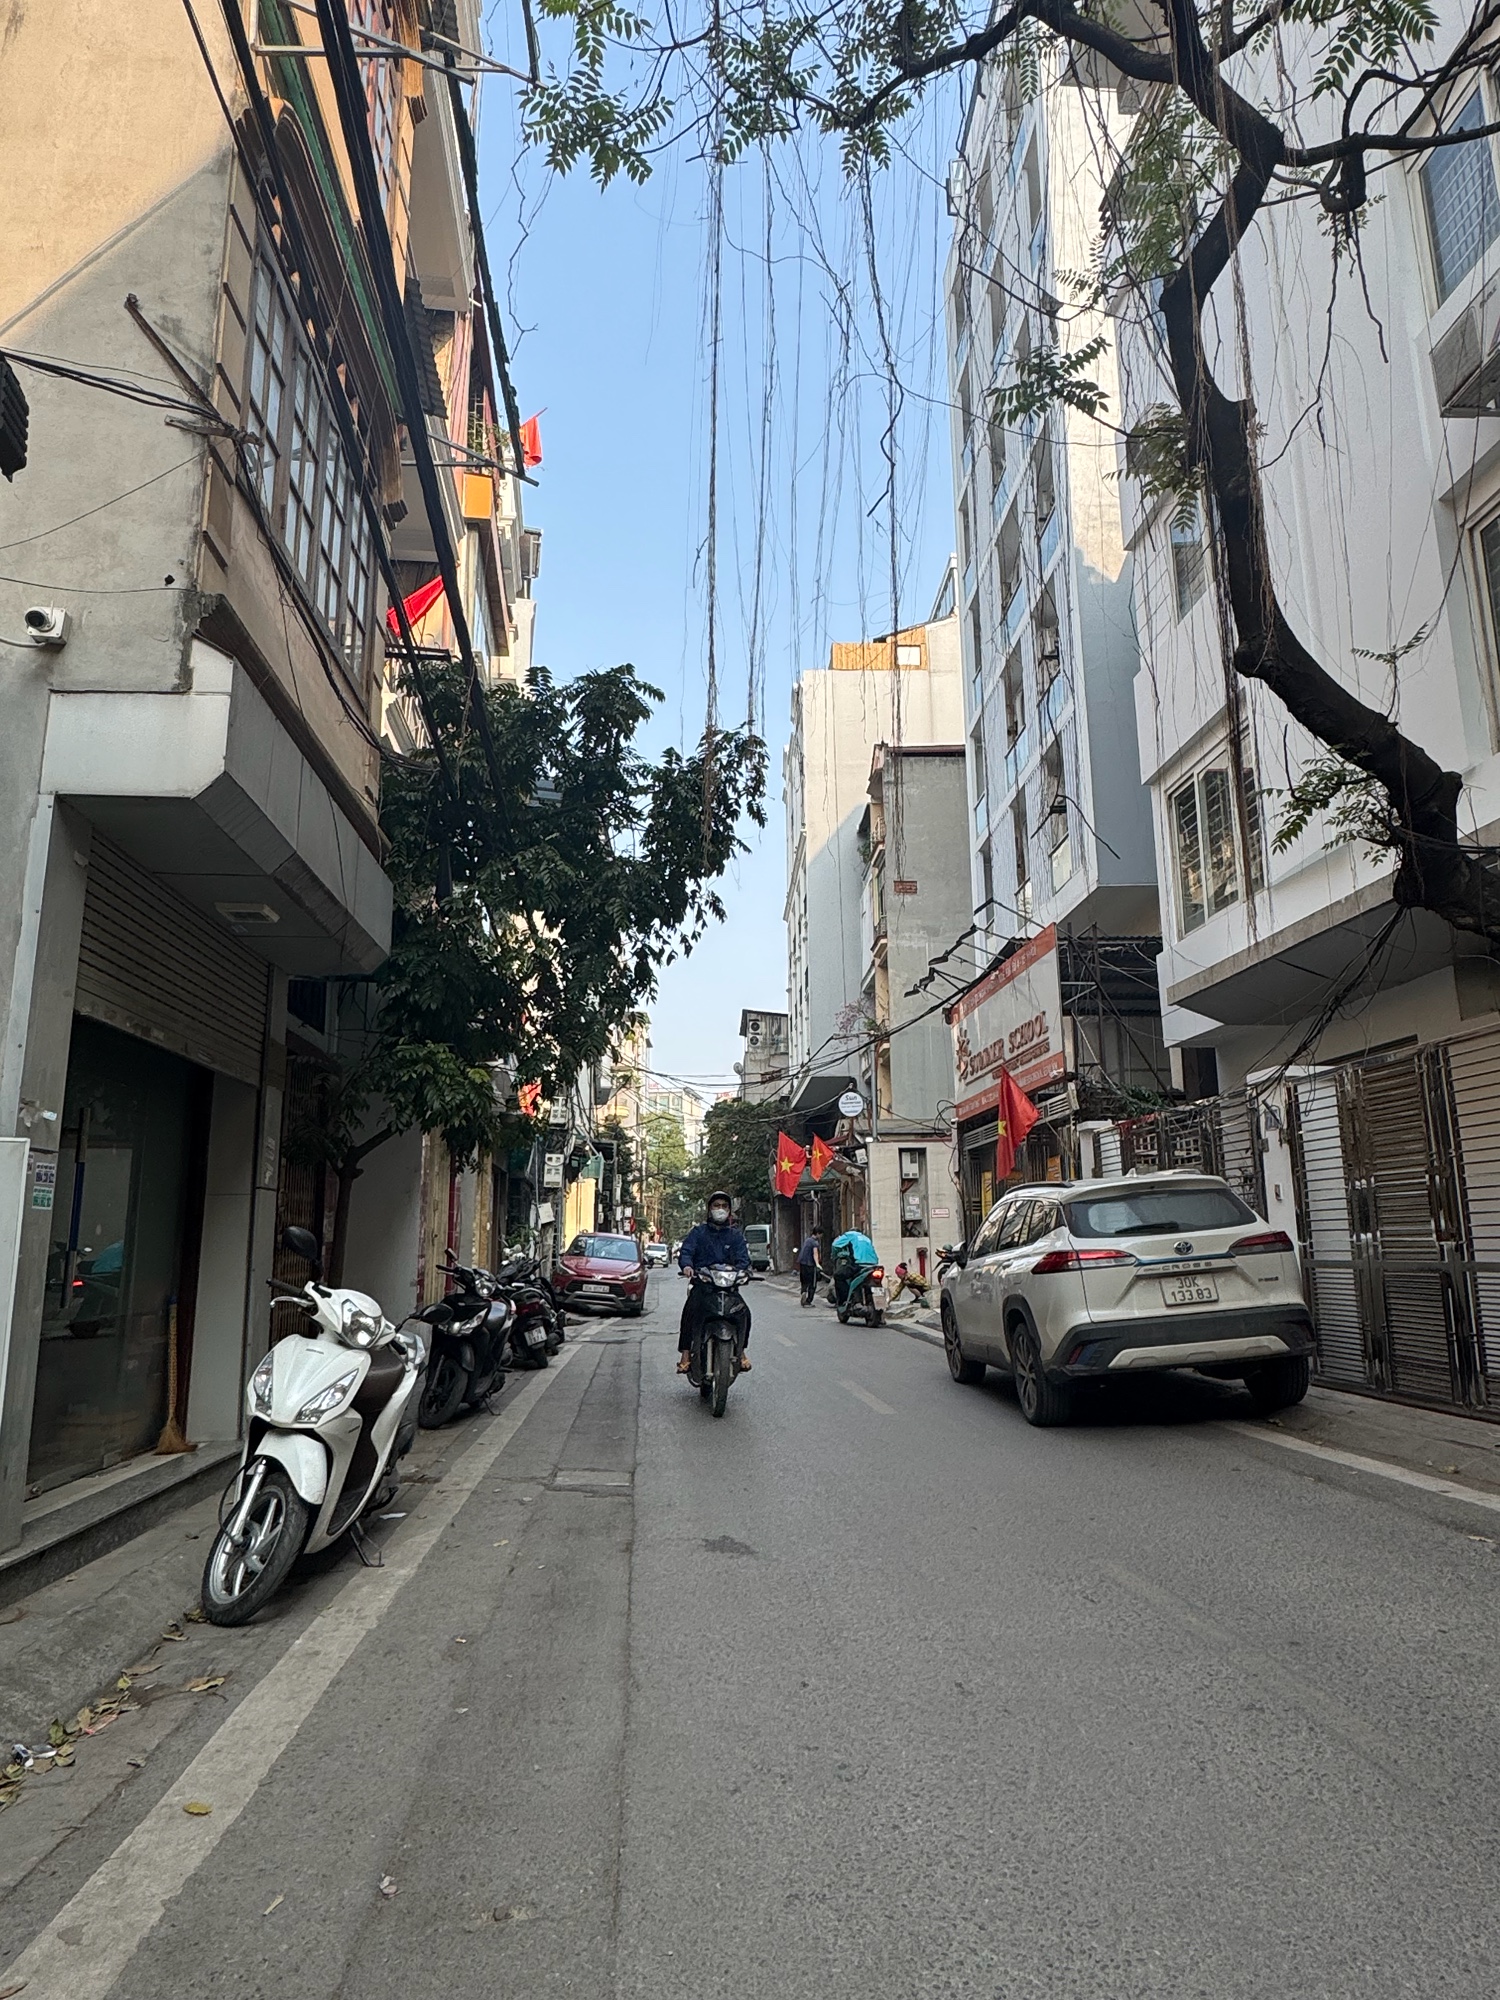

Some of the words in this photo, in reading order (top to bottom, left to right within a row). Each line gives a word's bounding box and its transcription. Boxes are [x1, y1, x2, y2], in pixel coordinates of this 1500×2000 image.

[1008, 1011, 1049, 1053] SCHOOL
[1162, 1261, 1212, 1271] CROSS
[1176, 1276, 1199, 1289] 30K
[1171, 1287, 1212, 1302] 133.83
